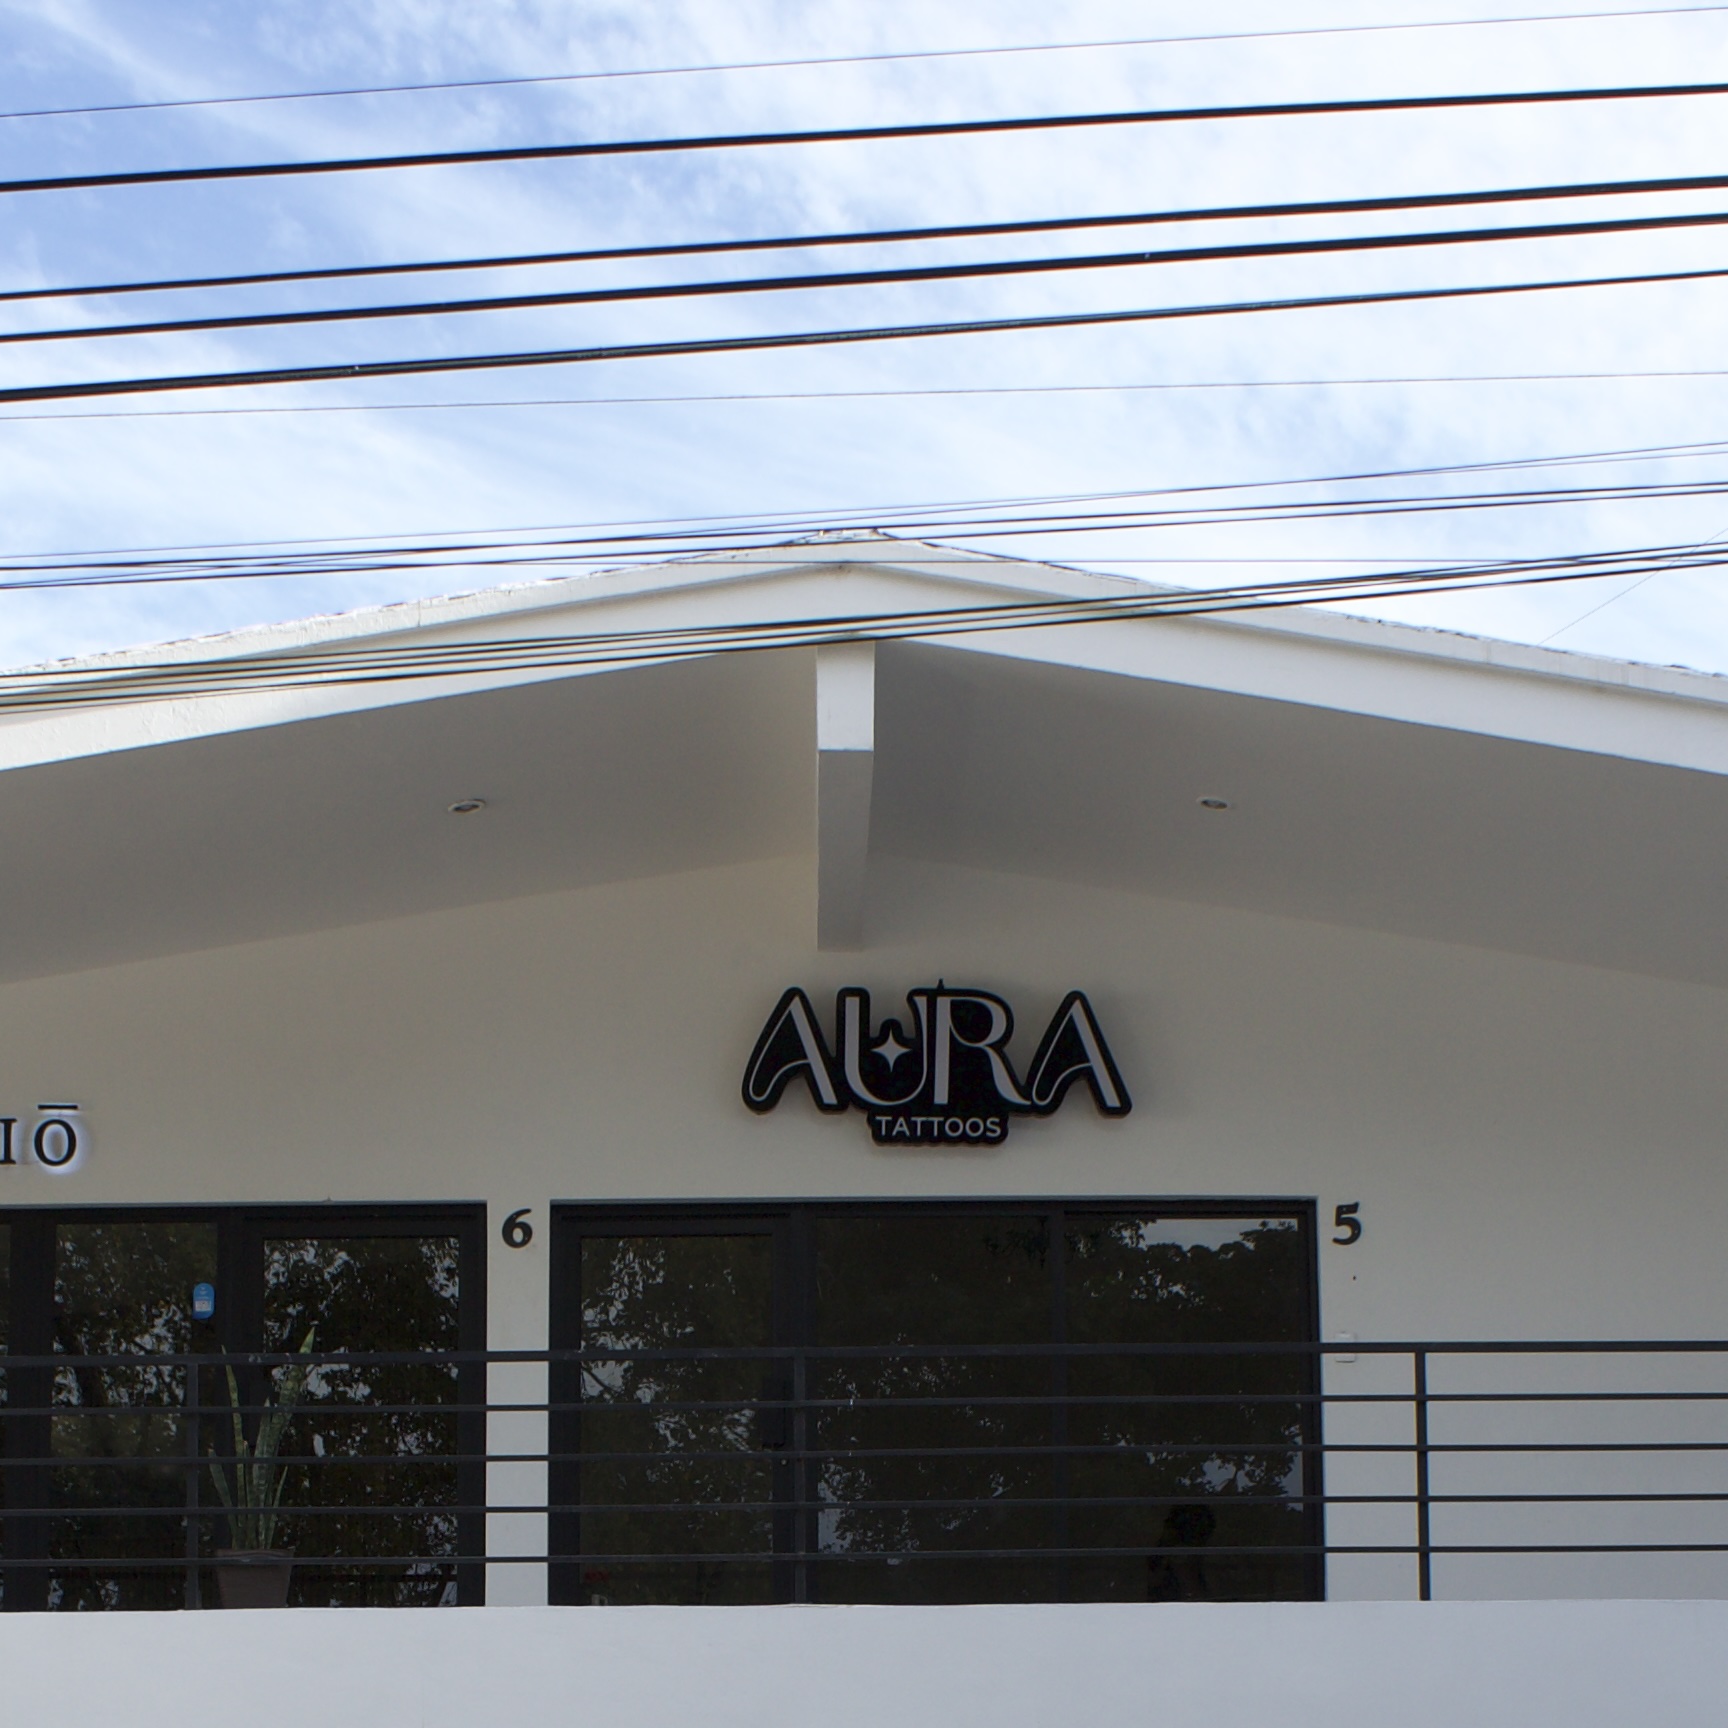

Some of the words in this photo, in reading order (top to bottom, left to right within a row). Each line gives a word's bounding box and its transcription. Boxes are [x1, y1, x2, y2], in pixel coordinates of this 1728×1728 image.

[741, 985, 1133, 1117] AURA
[875, 1115, 1003, 1138] TATTOOS
[501, 1207, 533, 1248] 6
[1332, 1201, 1362, 1245] 5
